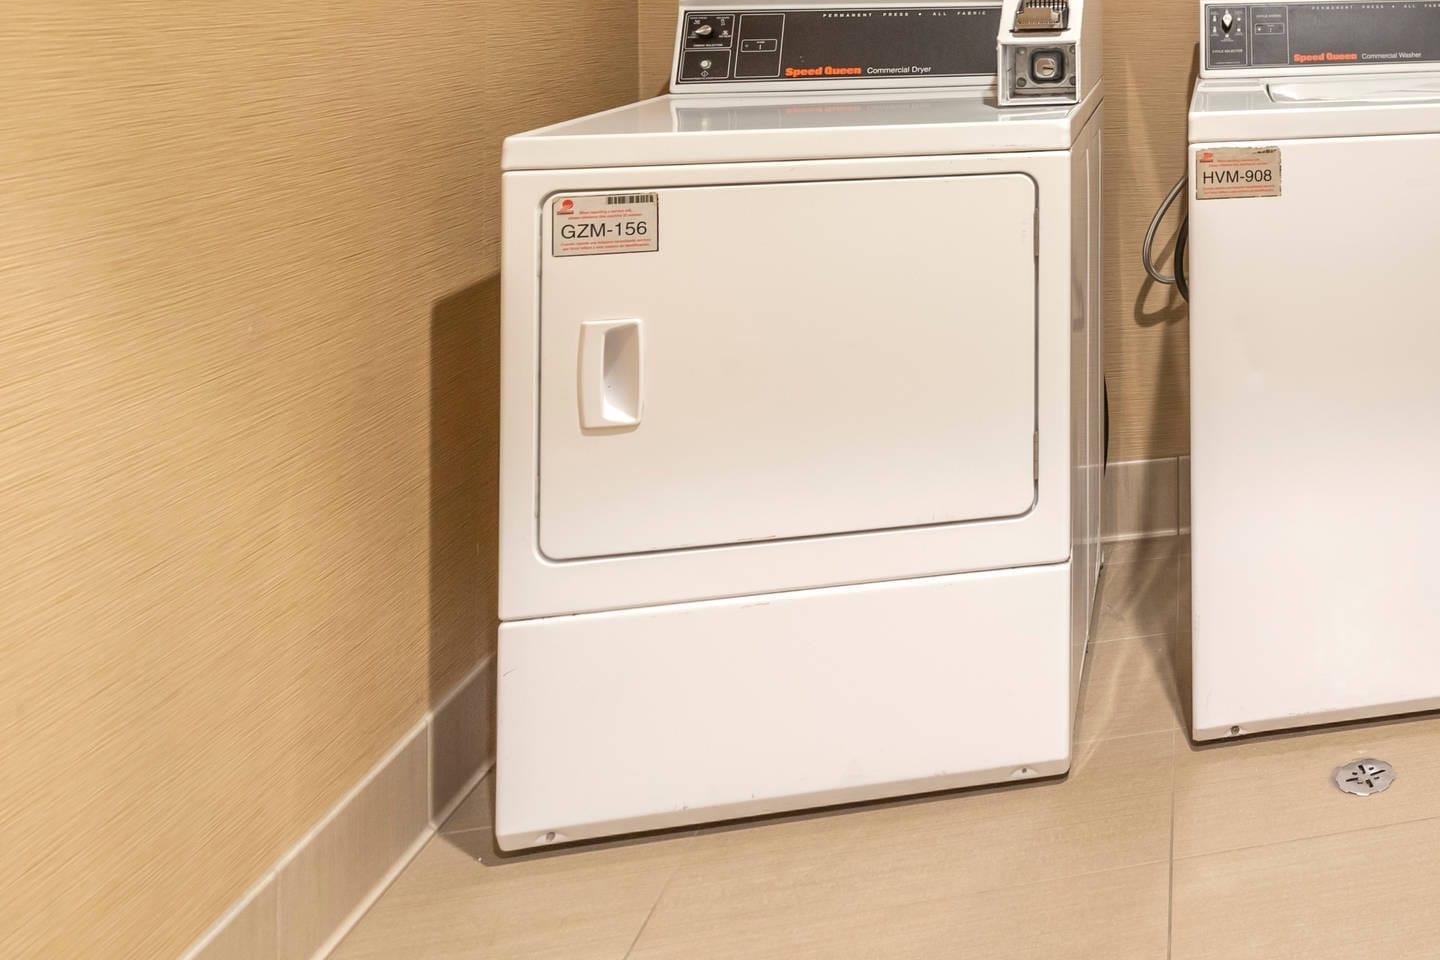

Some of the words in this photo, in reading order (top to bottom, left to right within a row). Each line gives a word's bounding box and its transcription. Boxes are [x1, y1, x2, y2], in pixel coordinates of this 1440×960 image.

[1293, 53, 1325, 63] Speed
[1326, 52, 1358, 61] Queen
[1361, 52, 1397, 60] Commercial
[1398, 51, 1422, 59] Washer
[785, 66, 823, 78] Speed
[824, 65, 862, 76] Queen
[867, 65, 910, 75] Commercial
[911, 65, 932, 75] Dryer
[1202, 169, 1273, 185] HVM-908
[561, 221, 647, 239] GZM-156
